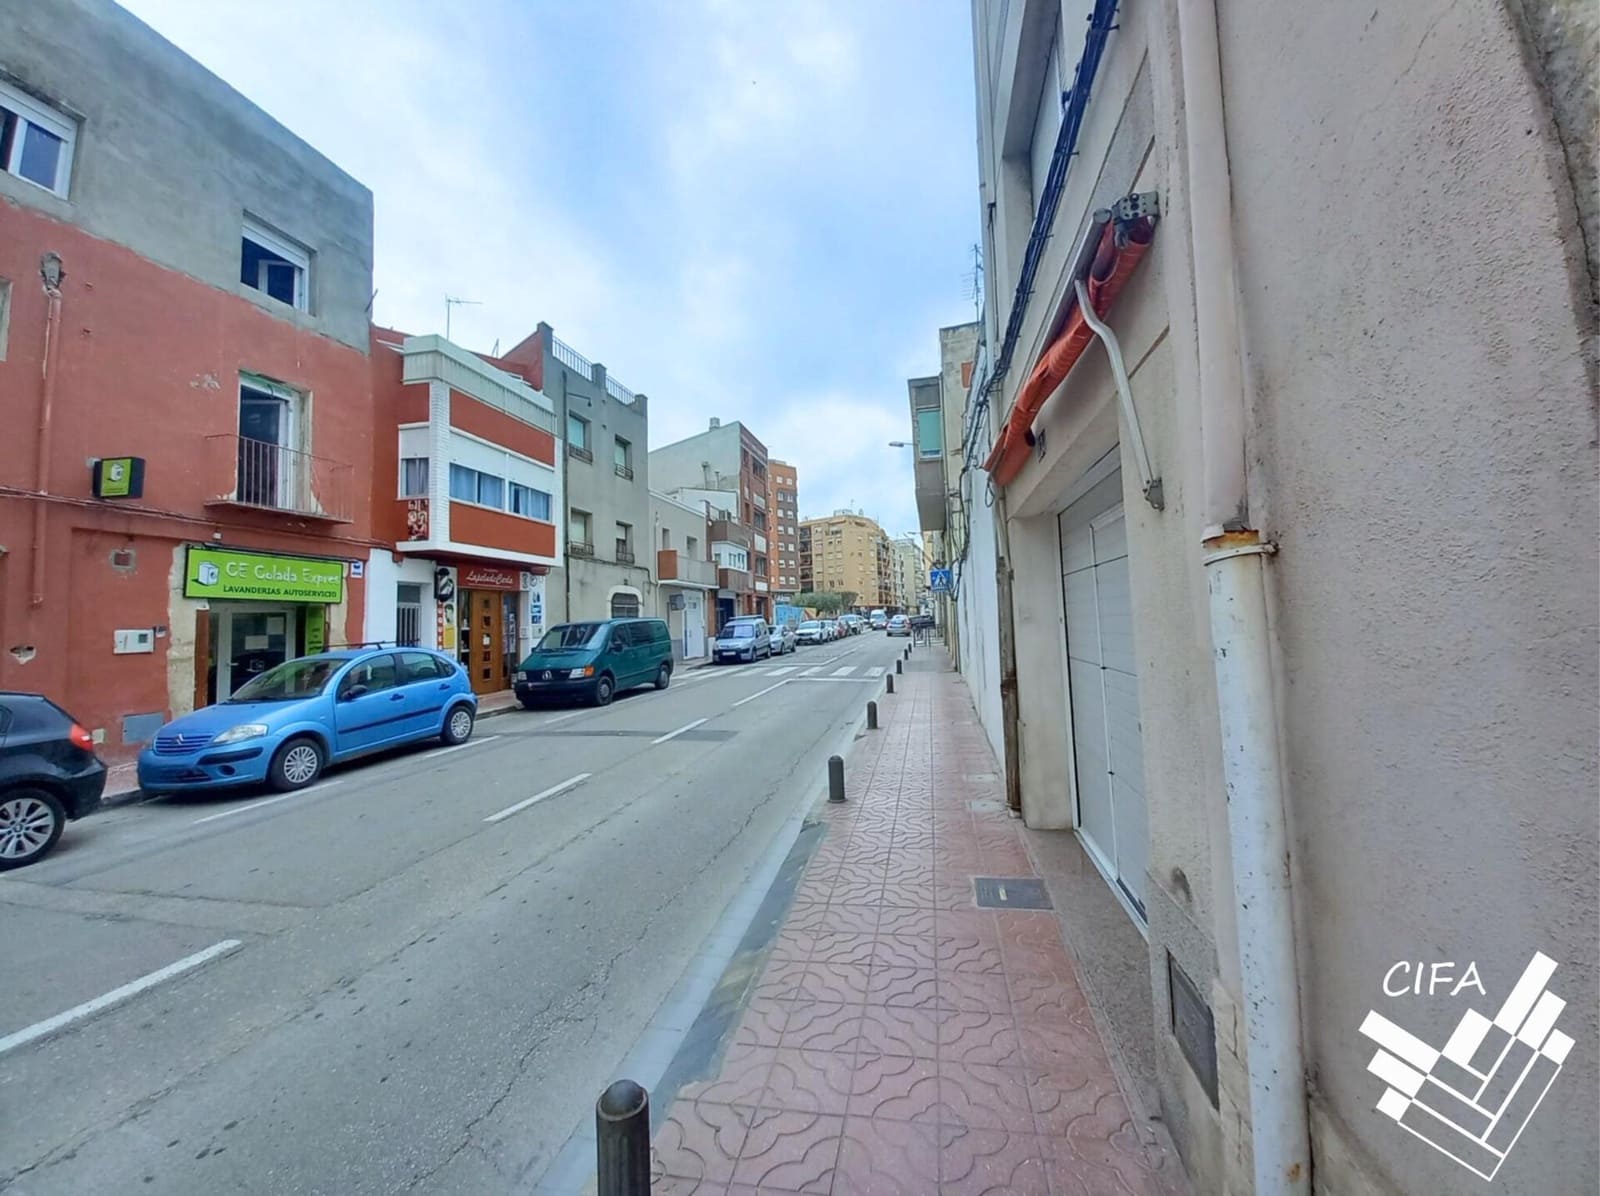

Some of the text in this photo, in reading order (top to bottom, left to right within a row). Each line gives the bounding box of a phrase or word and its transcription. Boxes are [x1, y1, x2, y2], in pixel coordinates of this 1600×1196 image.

[226, 561, 248, 578] CE
[254, 564, 297, 582] Colada
[223, 585, 337, 598] LAVANDERIAS AUTOSERVICIO
